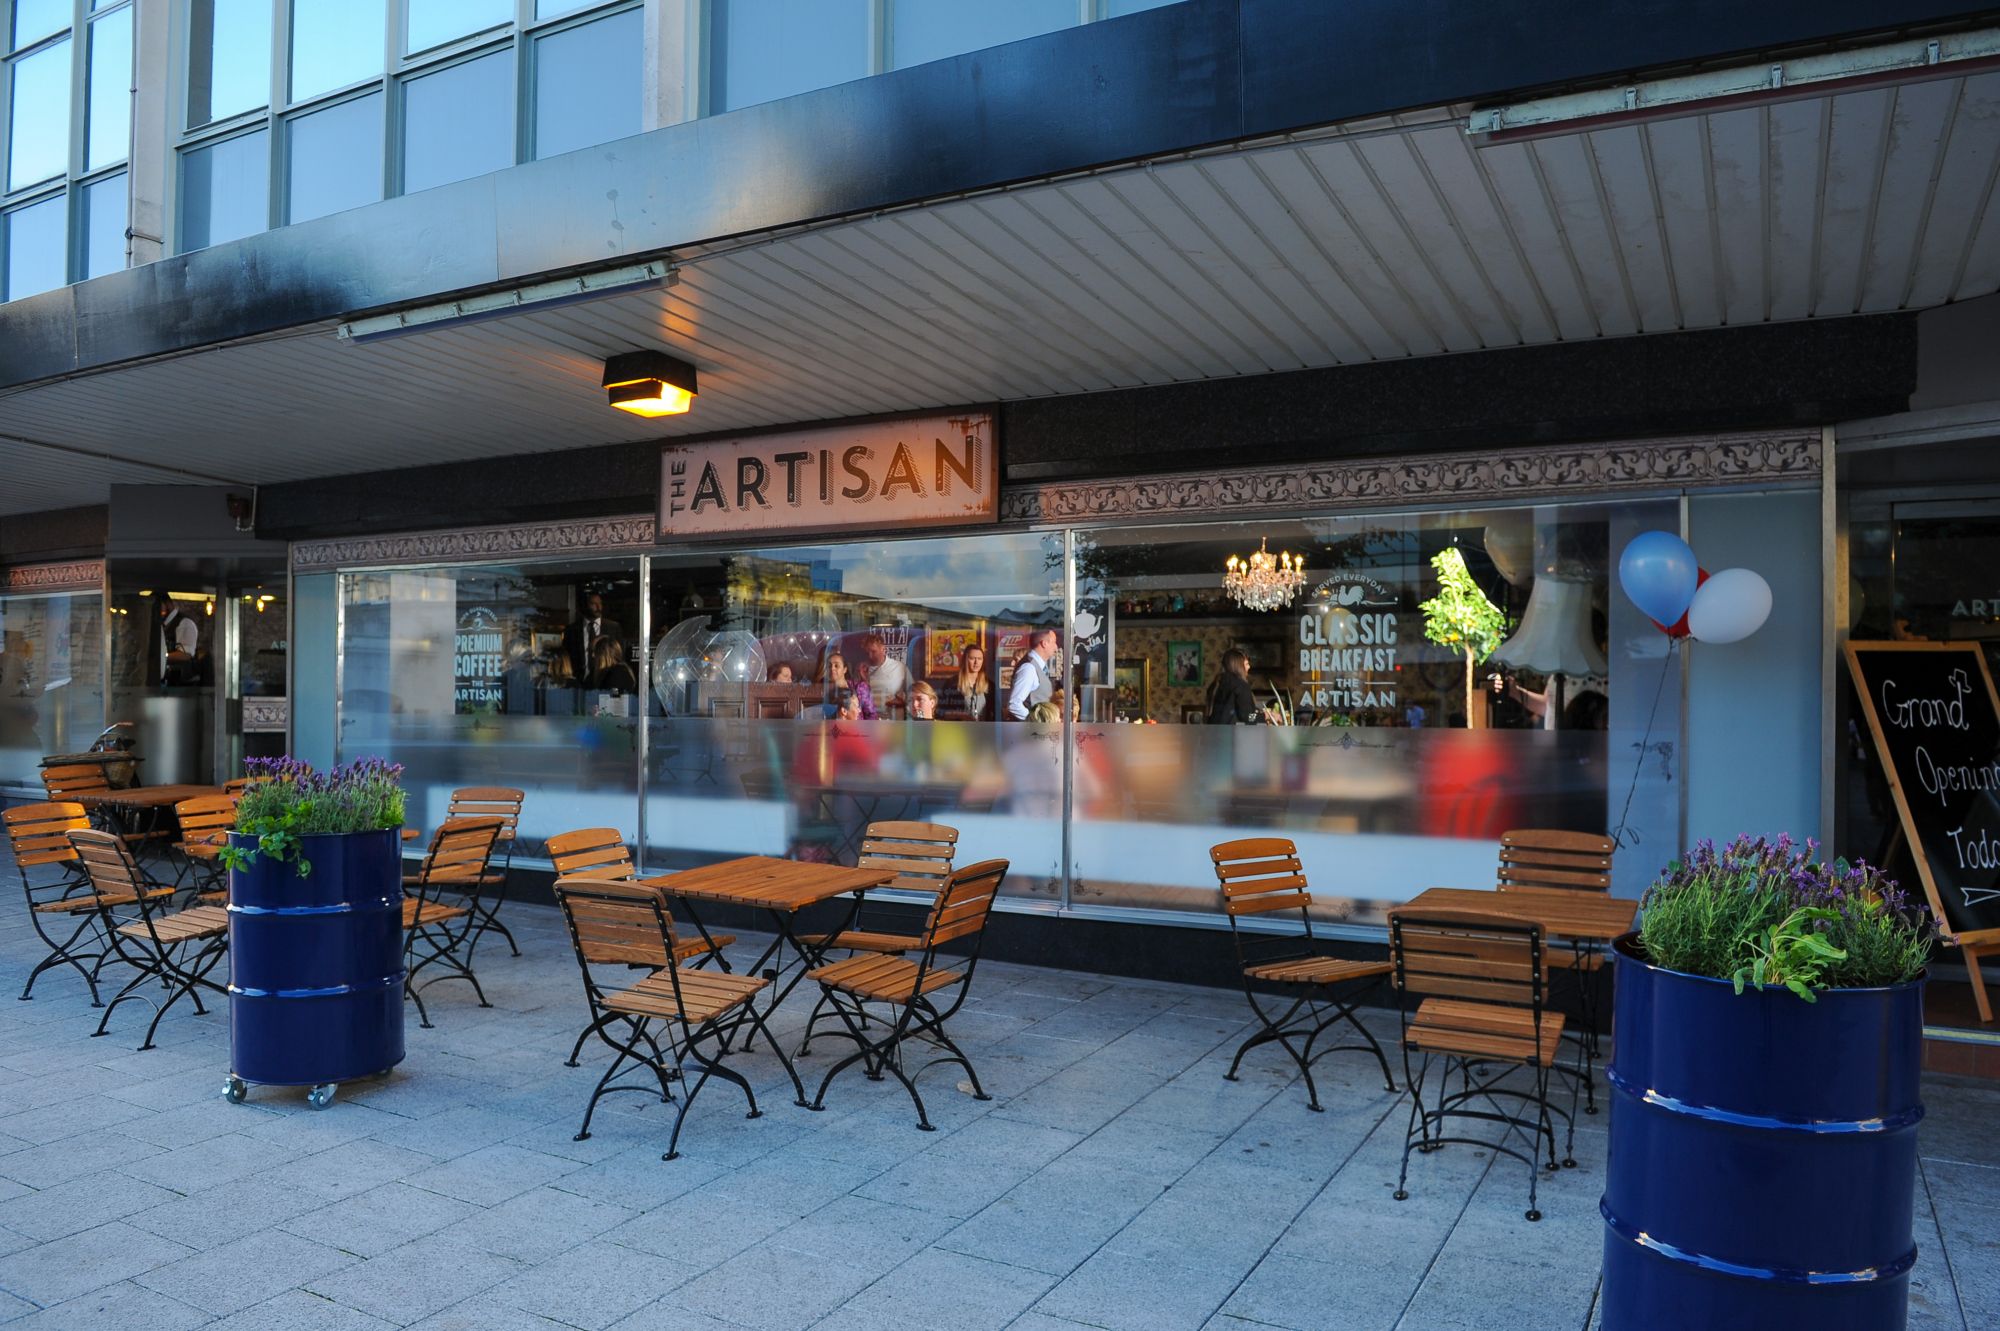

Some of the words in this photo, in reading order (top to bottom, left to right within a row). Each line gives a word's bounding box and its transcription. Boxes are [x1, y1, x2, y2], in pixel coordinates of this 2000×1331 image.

[670, 459, 687, 518] THE
[690, 435, 984, 514] ARTISAN
[1311, 575, 1341, 599] SERVED
[1343, 573, 1388, 596] EVERYDAY
[1300, 613, 1398, 646] CLASSIC
[454, 634, 503, 653] PREMIUM
[454, 654, 503, 677] COFFEE
[1300, 648, 1397, 672] BREAKFAST
[454, 688, 502, 701] ARTISAN
[1335, 678, 1360, 688] THE
[1300, 690, 1396, 708] ARTISAN
[1882, 679, 1970, 731] Grand
